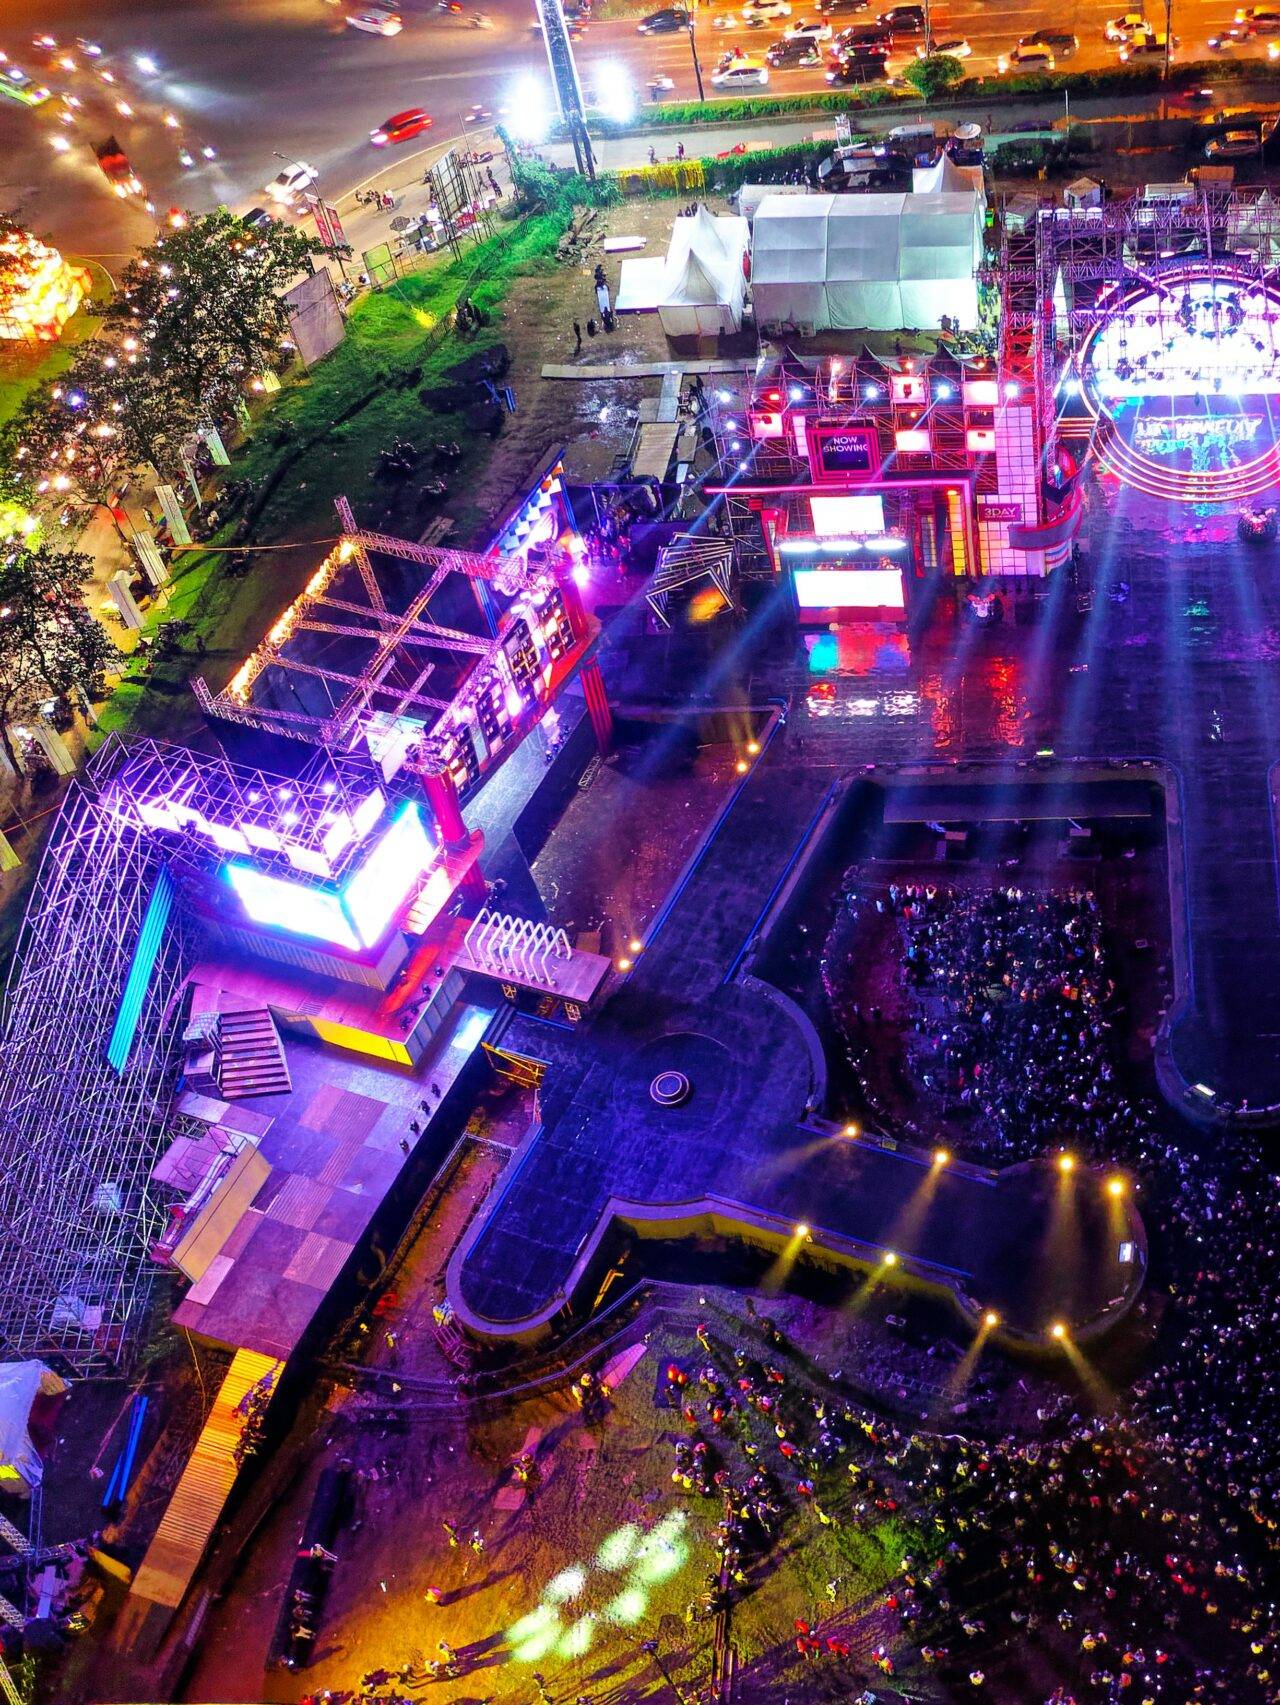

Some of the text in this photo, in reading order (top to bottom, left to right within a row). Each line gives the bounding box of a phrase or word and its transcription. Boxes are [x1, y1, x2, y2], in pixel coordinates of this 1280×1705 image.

[833, 436, 858, 444] NOW
[823, 444, 869, 452] SHOWING
[984, 507, 1016, 516] 3DAY
